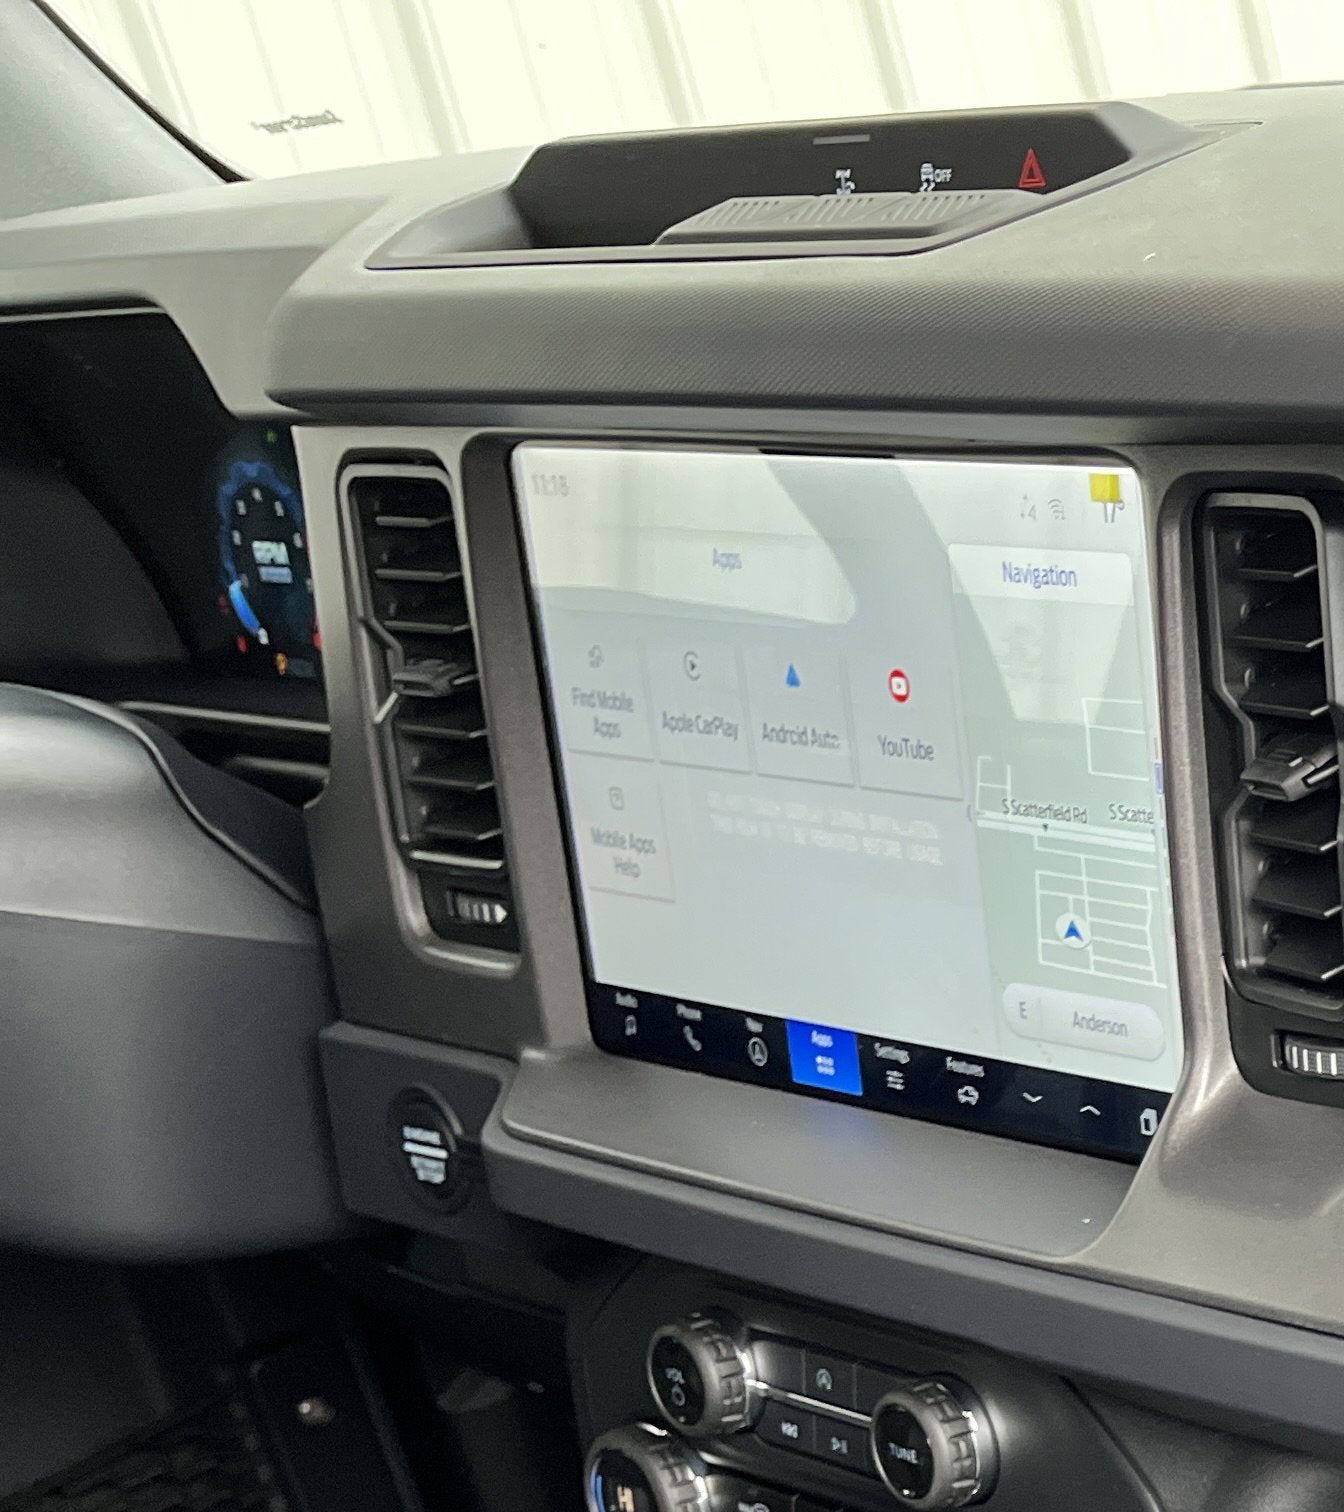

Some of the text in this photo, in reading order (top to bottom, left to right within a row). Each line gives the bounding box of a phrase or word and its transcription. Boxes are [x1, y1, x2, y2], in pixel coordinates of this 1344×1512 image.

[712, 547, 742, 573] Apps
[1001, 561, 1078, 589] Navigation
[593, 717, 622, 740] Apps
[662, 711, 739, 742] Apple CarPlay
[762, 723, 841, 750] Android Auto
[877, 734, 935, 761] YouTube
[1010, 799, 1072, 822] Scatterfield
[1073, 806, 1088, 824] Rd
[1072, 1010, 1129, 1038] Anderson
[889, 1442, 918, 1465] TUNE
